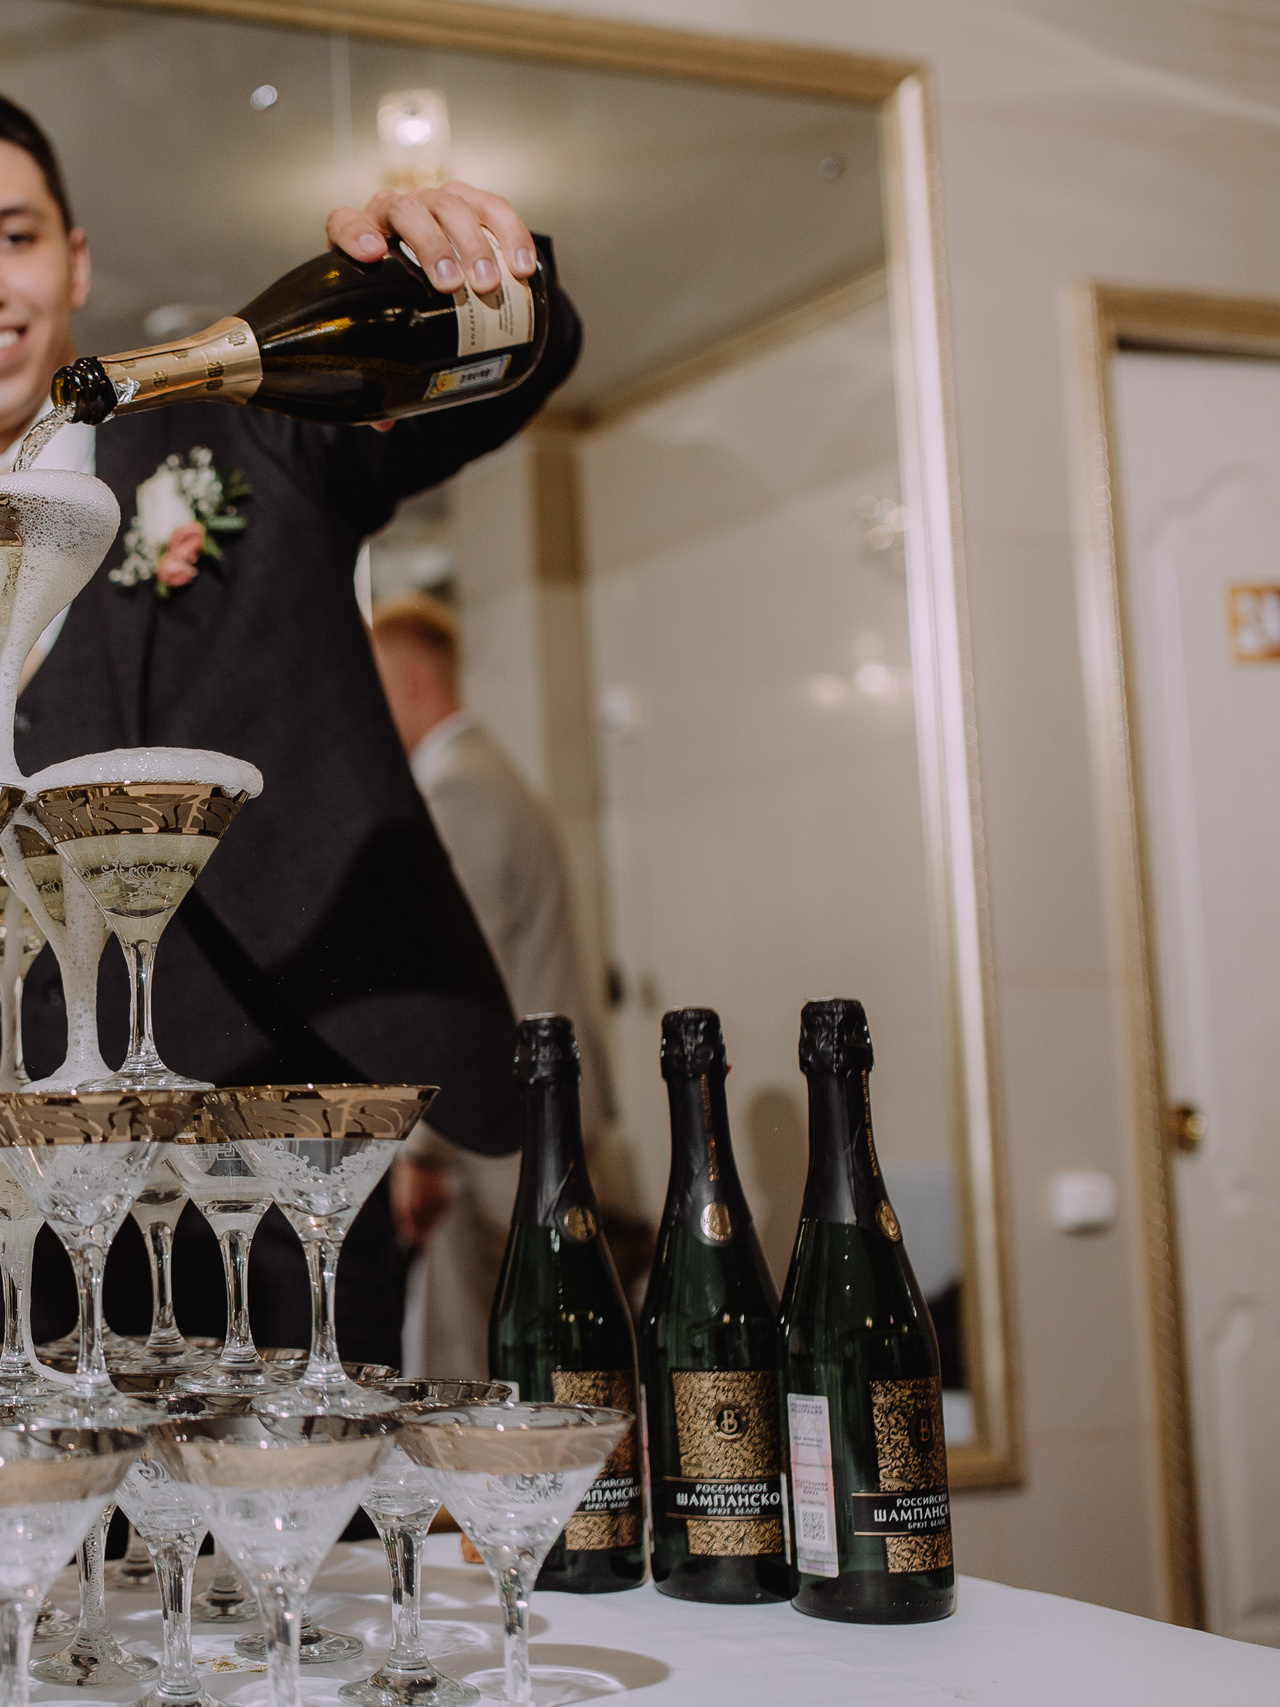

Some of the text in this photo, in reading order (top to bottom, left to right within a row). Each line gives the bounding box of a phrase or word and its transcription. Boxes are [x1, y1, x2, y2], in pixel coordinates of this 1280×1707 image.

[590, 1476, 634, 1489] ССИЙСКО
[695, 1482, 768, 1494] РОССИЙСКОЕ
[582, 1485, 640, 1502] МПАНСКО
[676, 1491, 780, 1507] ШАМПАНСКО
[907, 1520, 927, 1530] БРЮТ
